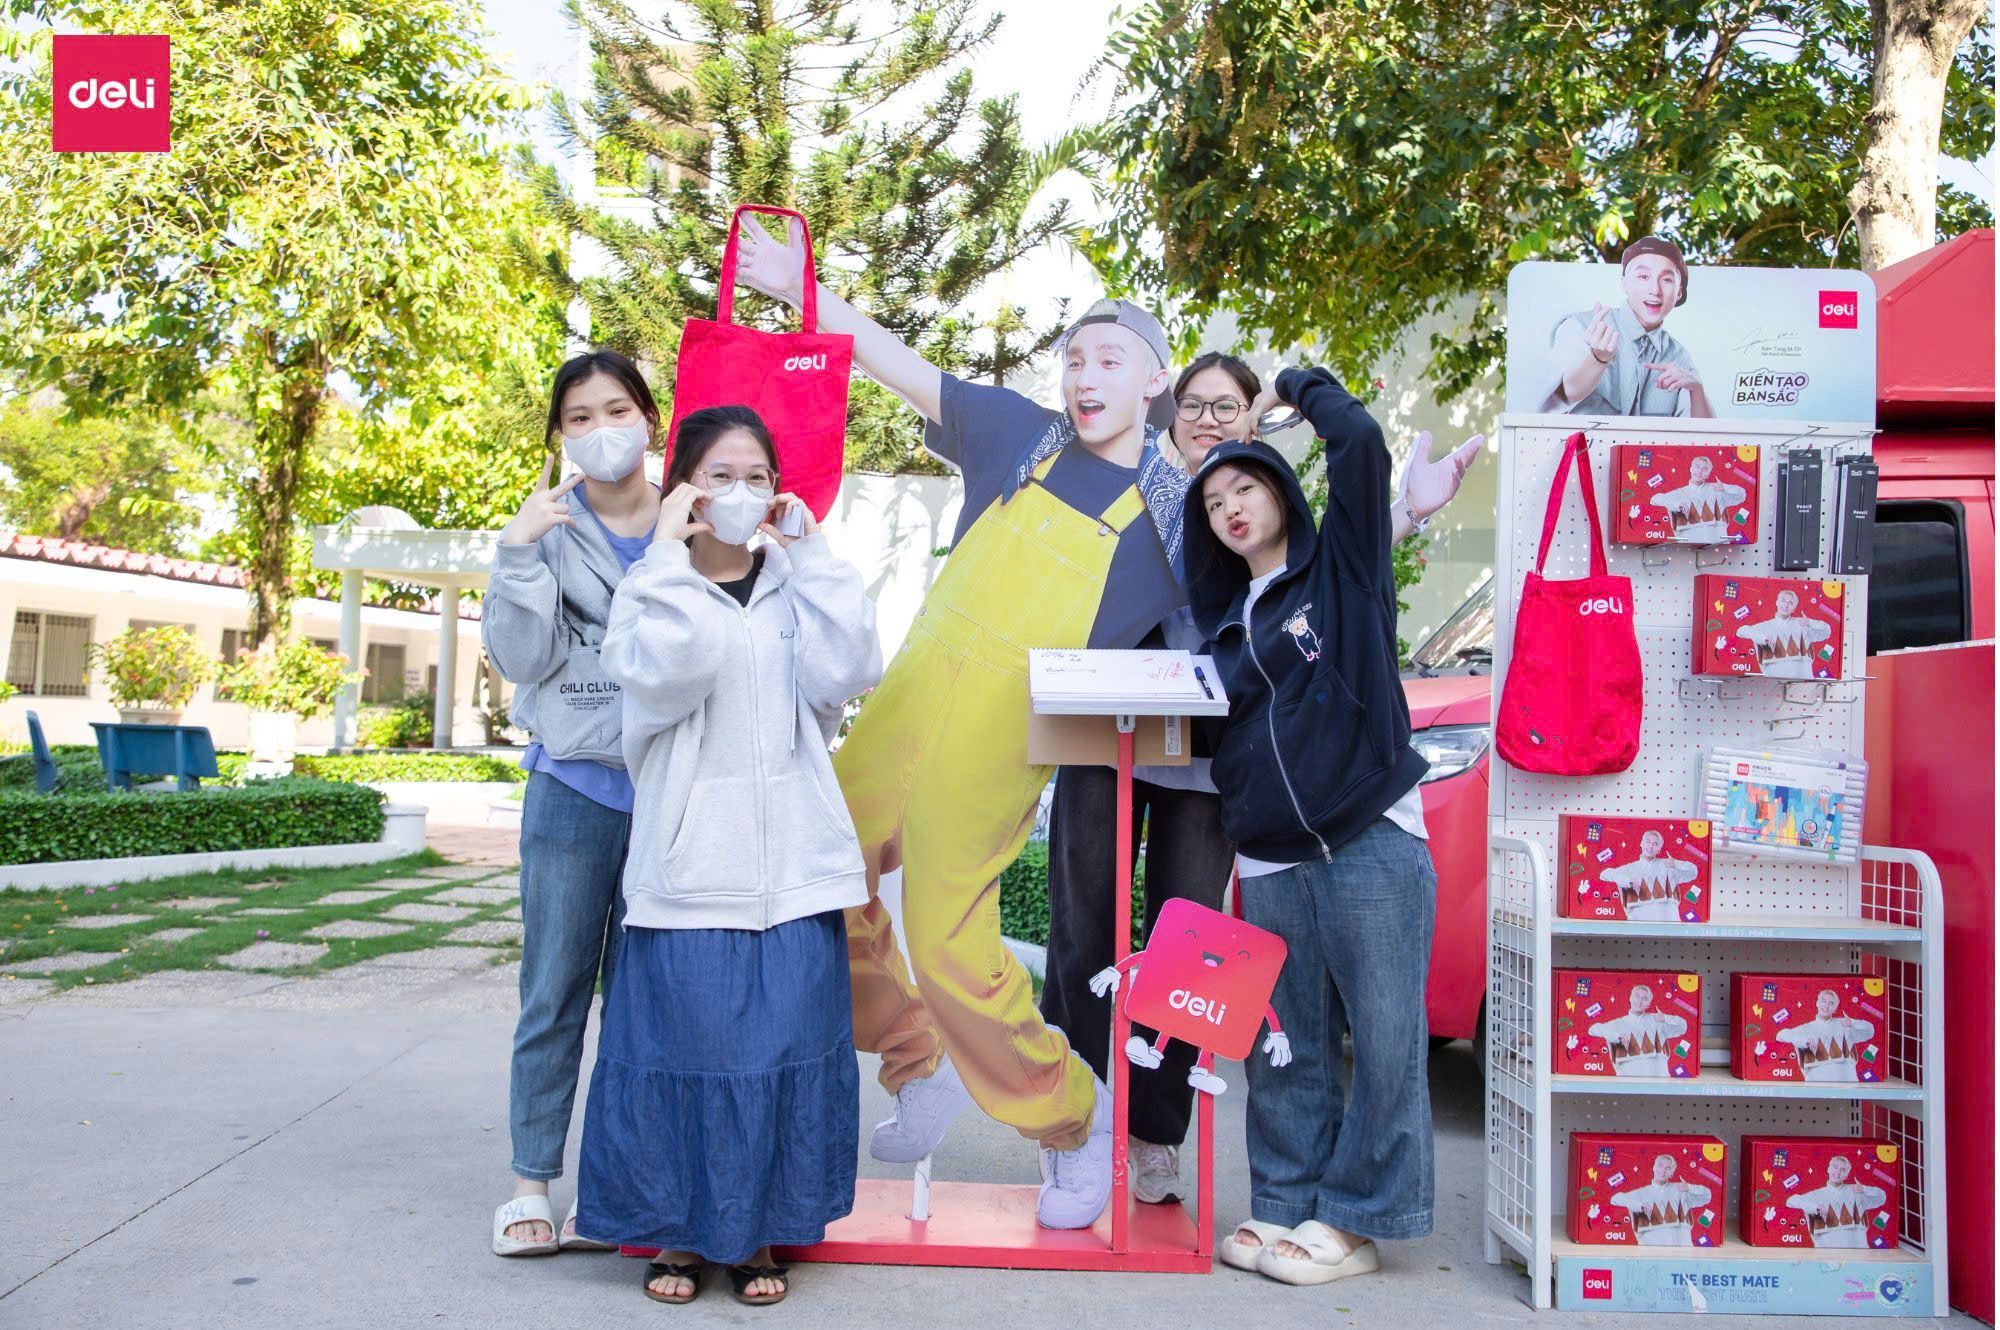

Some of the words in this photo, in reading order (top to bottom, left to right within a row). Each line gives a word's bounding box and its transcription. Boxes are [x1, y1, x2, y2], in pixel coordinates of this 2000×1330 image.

[1822, 304, 1855, 316] deli
[784, 353, 827, 372] deli
[1739, 371, 1774, 387] KIẾN
[1776, 376, 1806, 390] TẠO
[1736, 387, 1767, 402] BẢN
[1767, 389, 1796, 403] SẮC
[1645, 531, 1666, 540] deli
[1579, 596, 1623, 616] deli
[1732, 663, 1751, 672] deli
[560, 682, 584, 694] CHILI
[1595, 907, 1615, 916] deli
[1169, 989, 1226, 1025] deli
[1584, 1062, 1604, 1072] deli
[1772, 1068, 1793, 1077] deli
[1605, 1231, 1626, 1241] deli
[1781, 1234, 1802, 1243] deli
[1585, 1280, 1610, 1290] deli
[1671, 1273, 1698, 1286] THE
[1702, 1274, 1738, 1287] BEST
[1742, 1275, 1780, 1288] MATE
